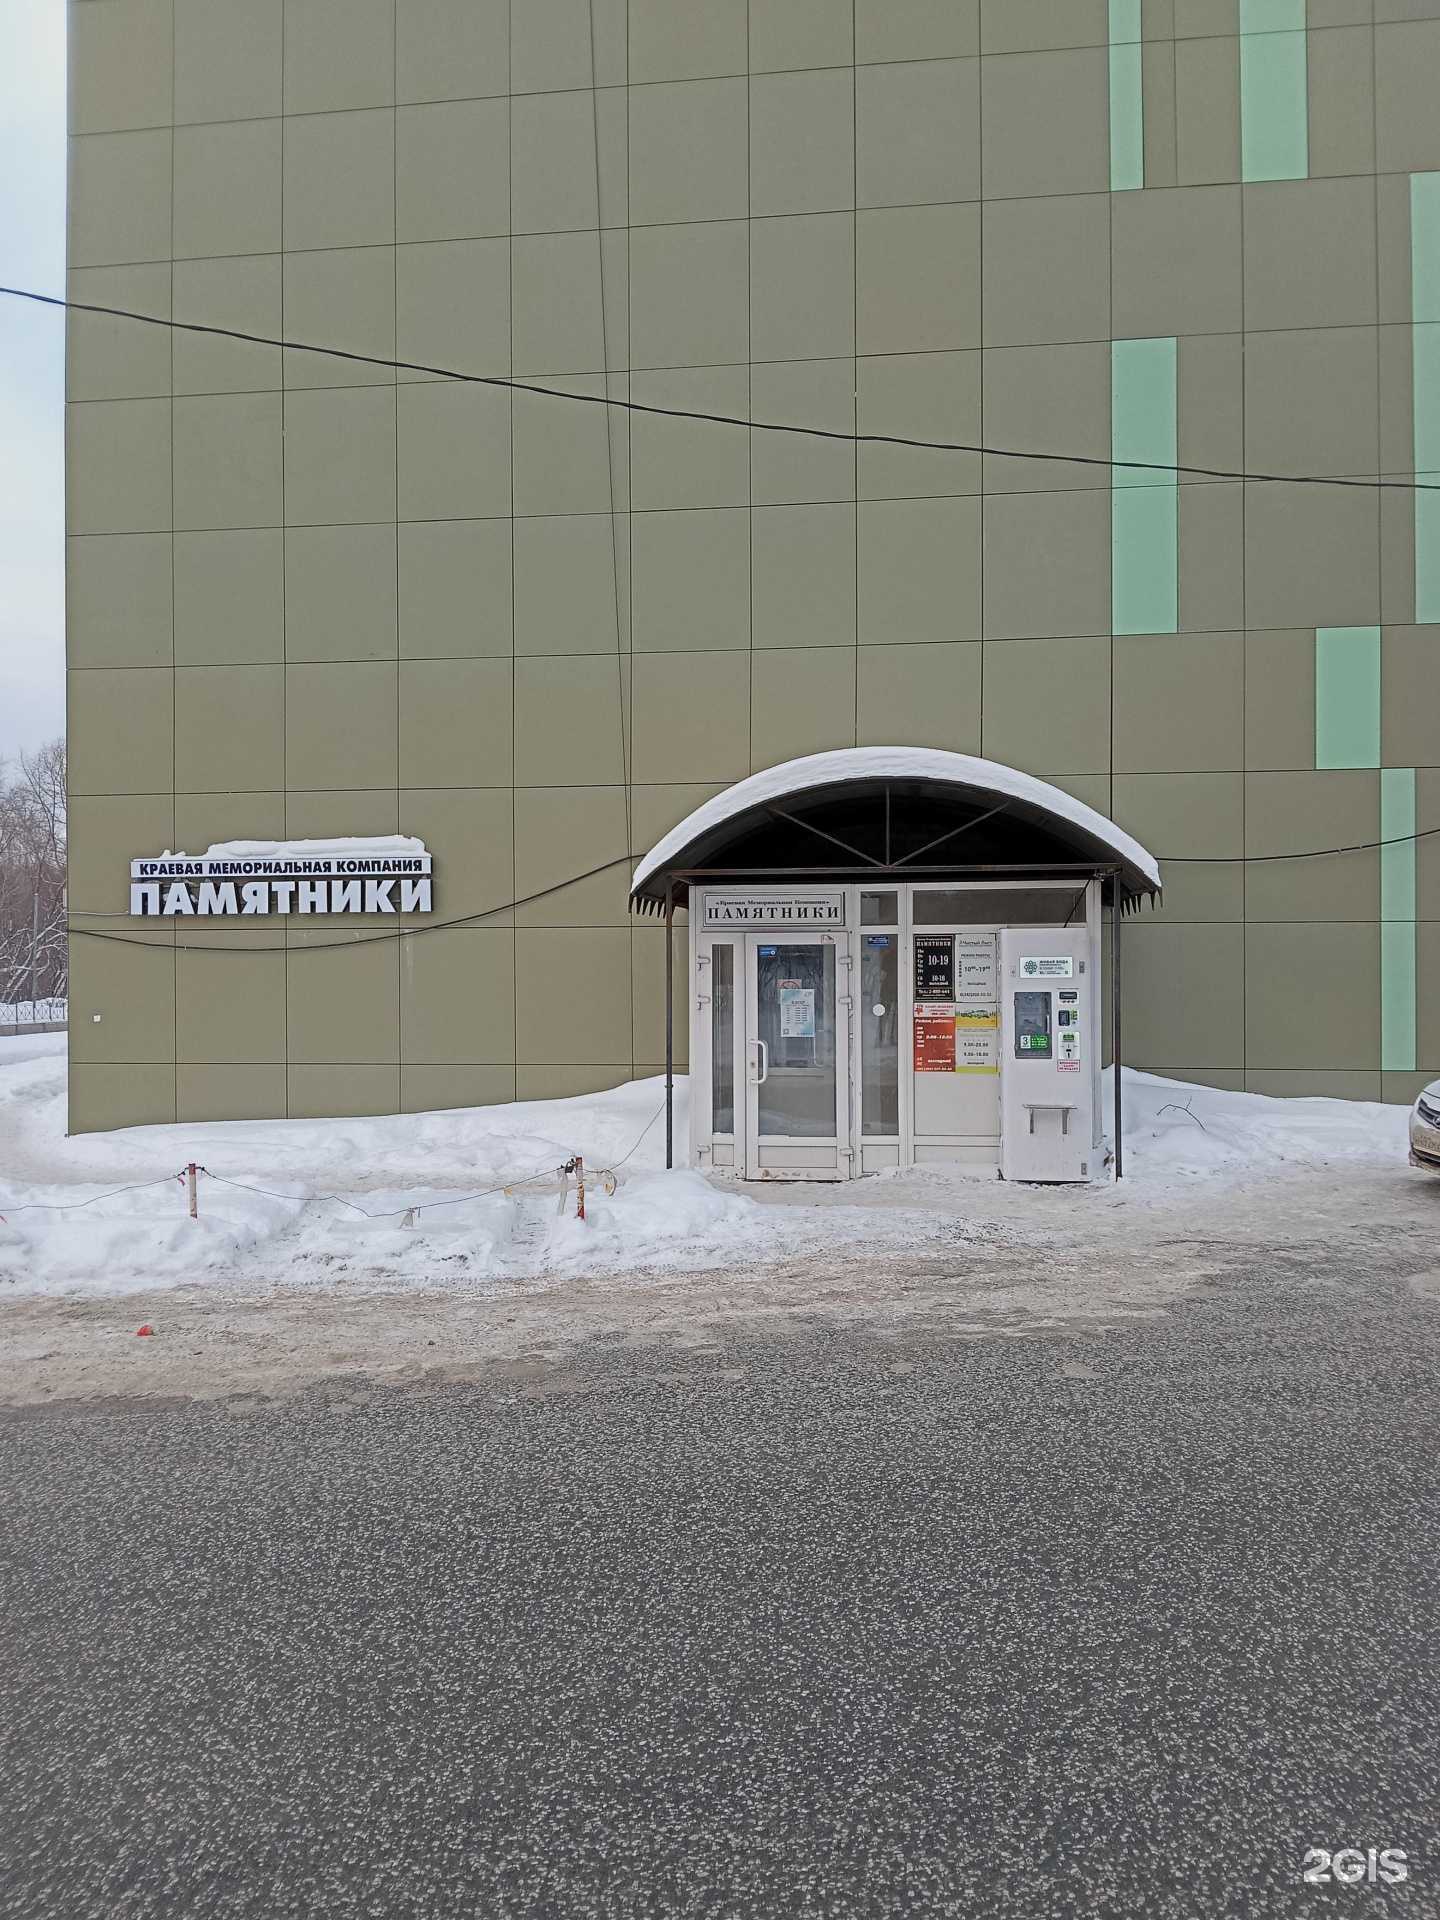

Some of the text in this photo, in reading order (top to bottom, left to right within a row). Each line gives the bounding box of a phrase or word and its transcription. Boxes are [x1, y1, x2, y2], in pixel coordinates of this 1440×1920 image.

[140, 859, 423, 876] КРАЕВАЯ МЕМОРИАЛЬНАЯ КОМПАНИЯ
[130, 878, 433, 915] ПАМЯТНИКИ
[707, 906, 840, 919] ПАМЯТНИКИ
[928, 954, 949, 966] 10-19
